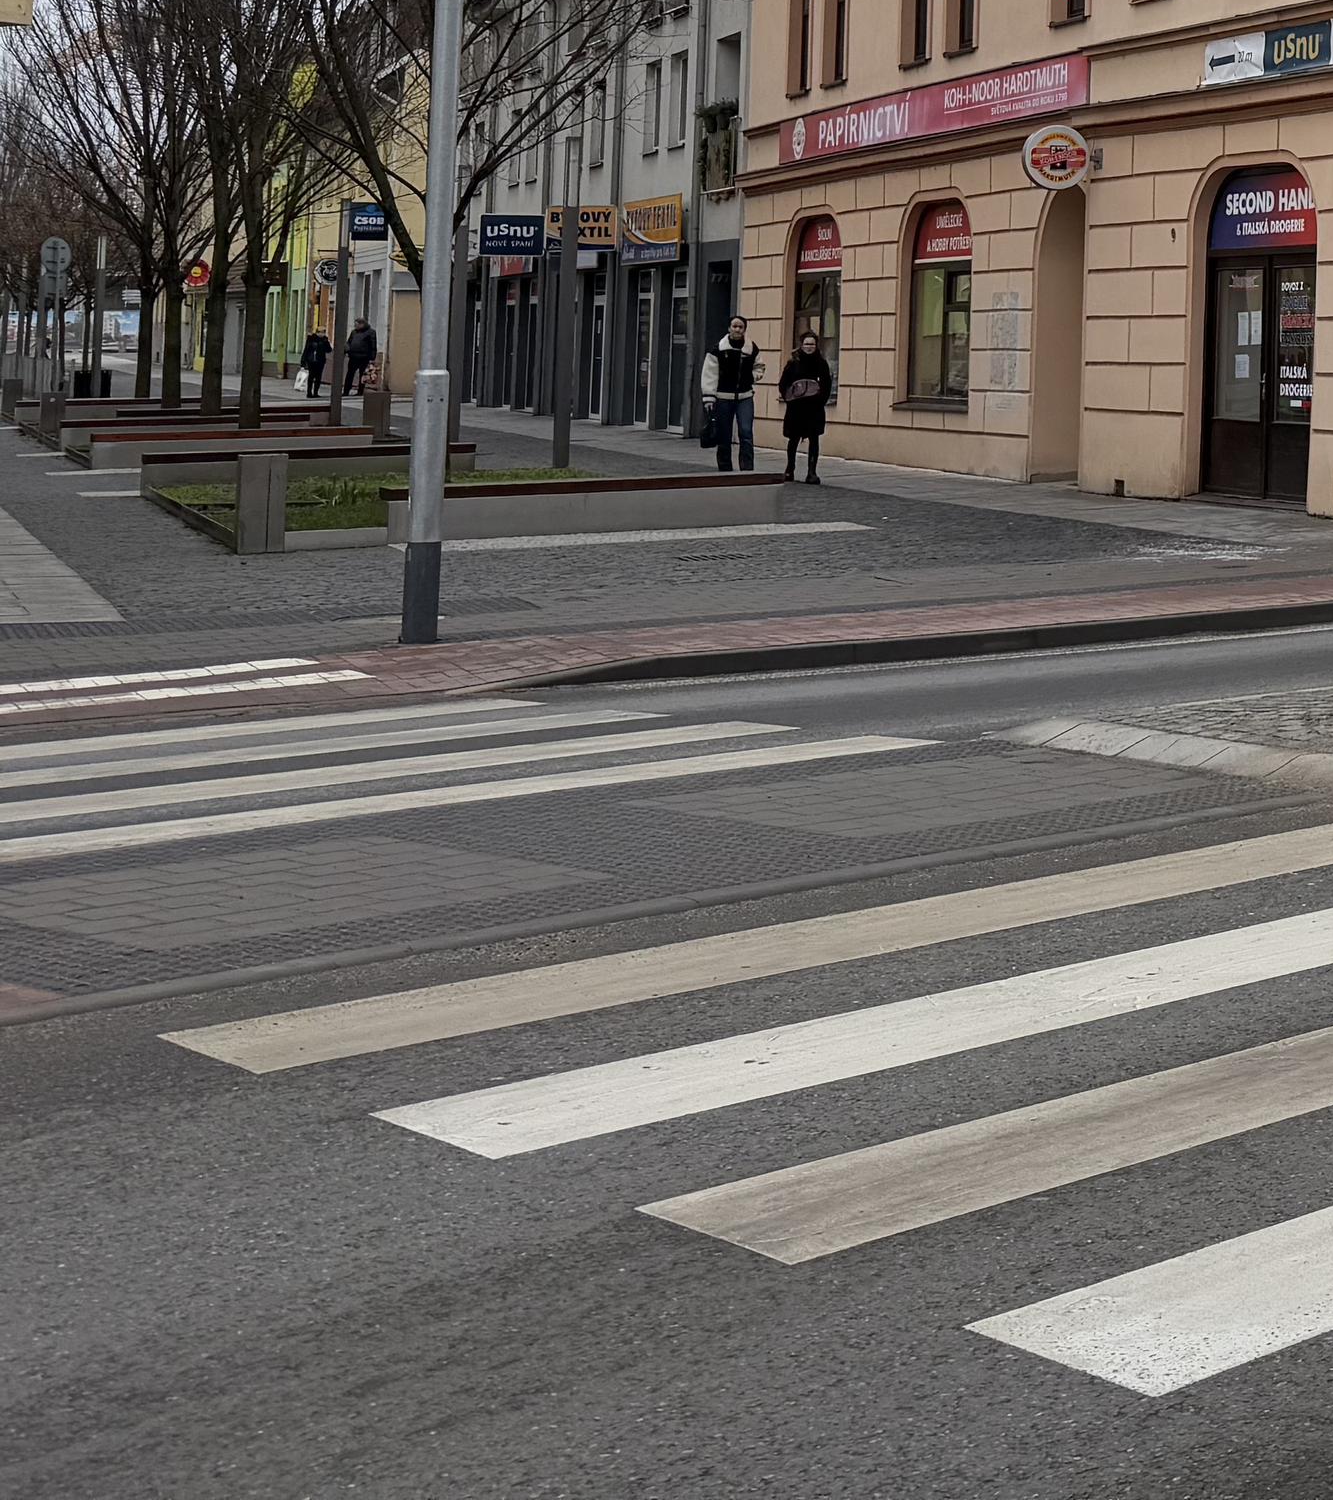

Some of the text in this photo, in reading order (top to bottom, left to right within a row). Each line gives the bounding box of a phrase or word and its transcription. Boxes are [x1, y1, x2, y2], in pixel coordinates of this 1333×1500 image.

[944, 62, 1068, 109] KOH-I-NOOR HARDTMUTH
[818, 91, 910, 149] PAPÍRNICTVÍ
[1225, 190, 1275, 216] SECOND
[354, 215, 385, 225] ČSOB
[550, 208, 612, 223] BOVÝ
[557, 226, 612, 238] TXTIL
[1242, 218, 1269, 236] ITALSKÁ
[1270, 218, 1305, 233] DROGERIE
[486, 238, 534, 247] NOVÉ SPANÍ
[932, 238, 950, 252] HOBBY
[1280, 363, 1308, 379] ITALSKÁ
